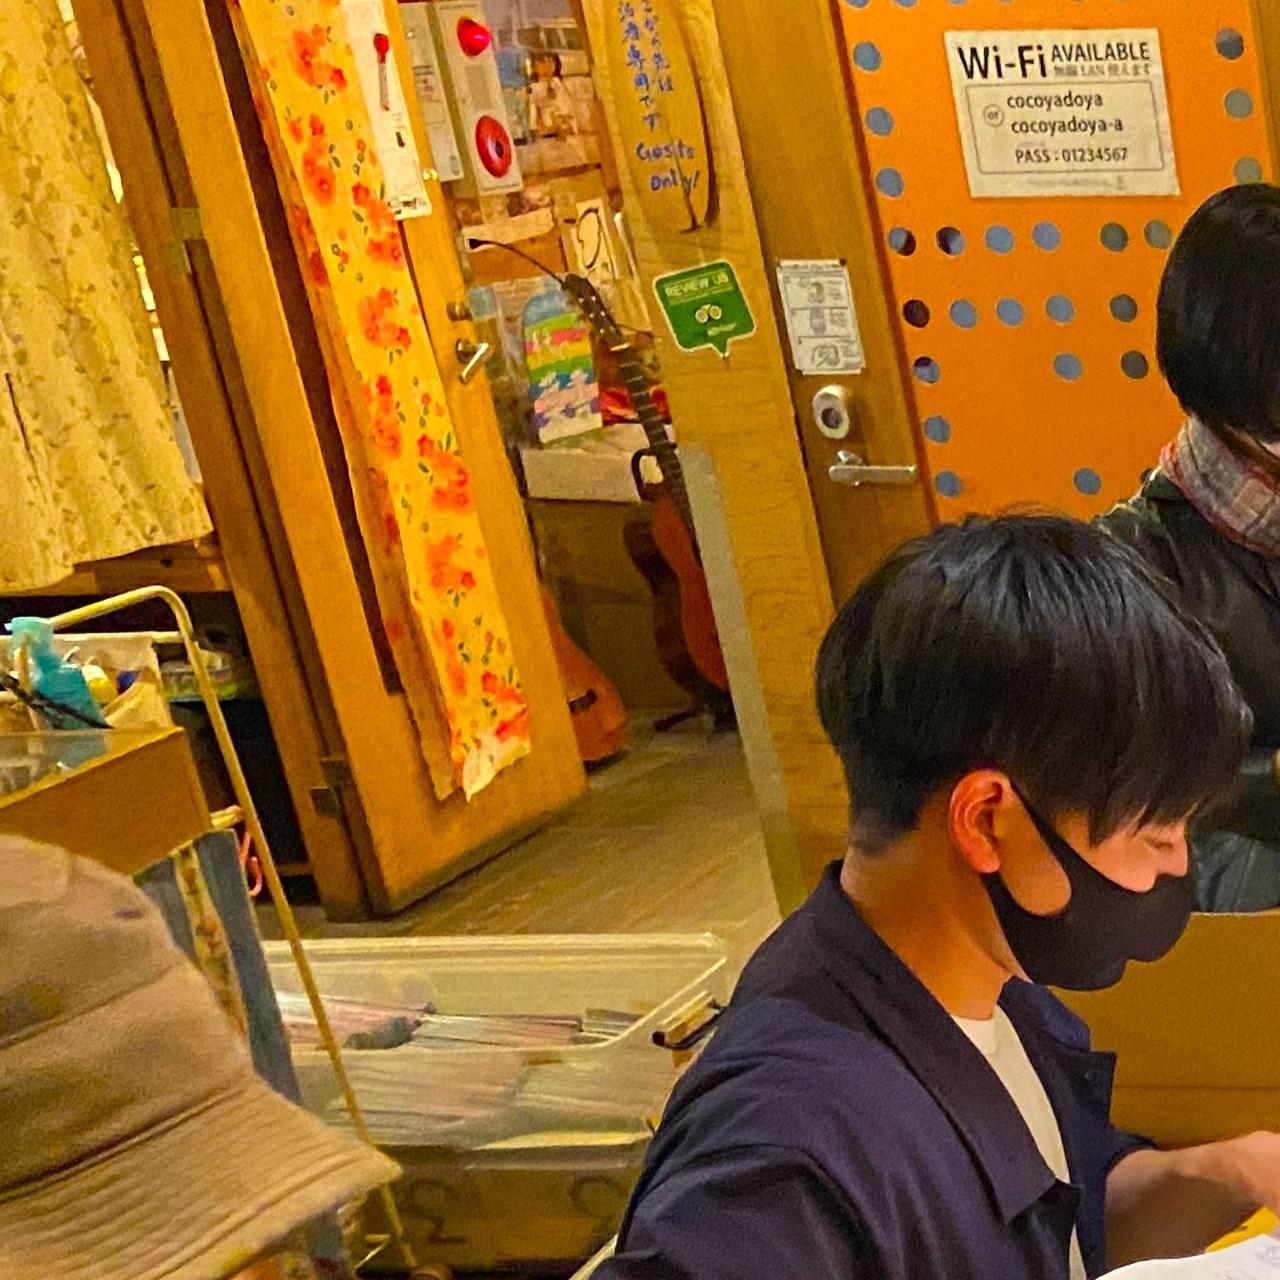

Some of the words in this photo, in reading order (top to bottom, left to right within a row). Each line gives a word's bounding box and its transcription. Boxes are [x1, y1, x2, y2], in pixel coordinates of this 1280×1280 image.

[957, 45, 1048, 79] Wi-Fi
[1051, 42, 1151, 62] AVAILABLE
[1007, 90, 1104, 112] cocoyadoya
[1011, 116, 1124, 137] cocoyadoya-a
[665, 277, 711, 298] REVIEW
